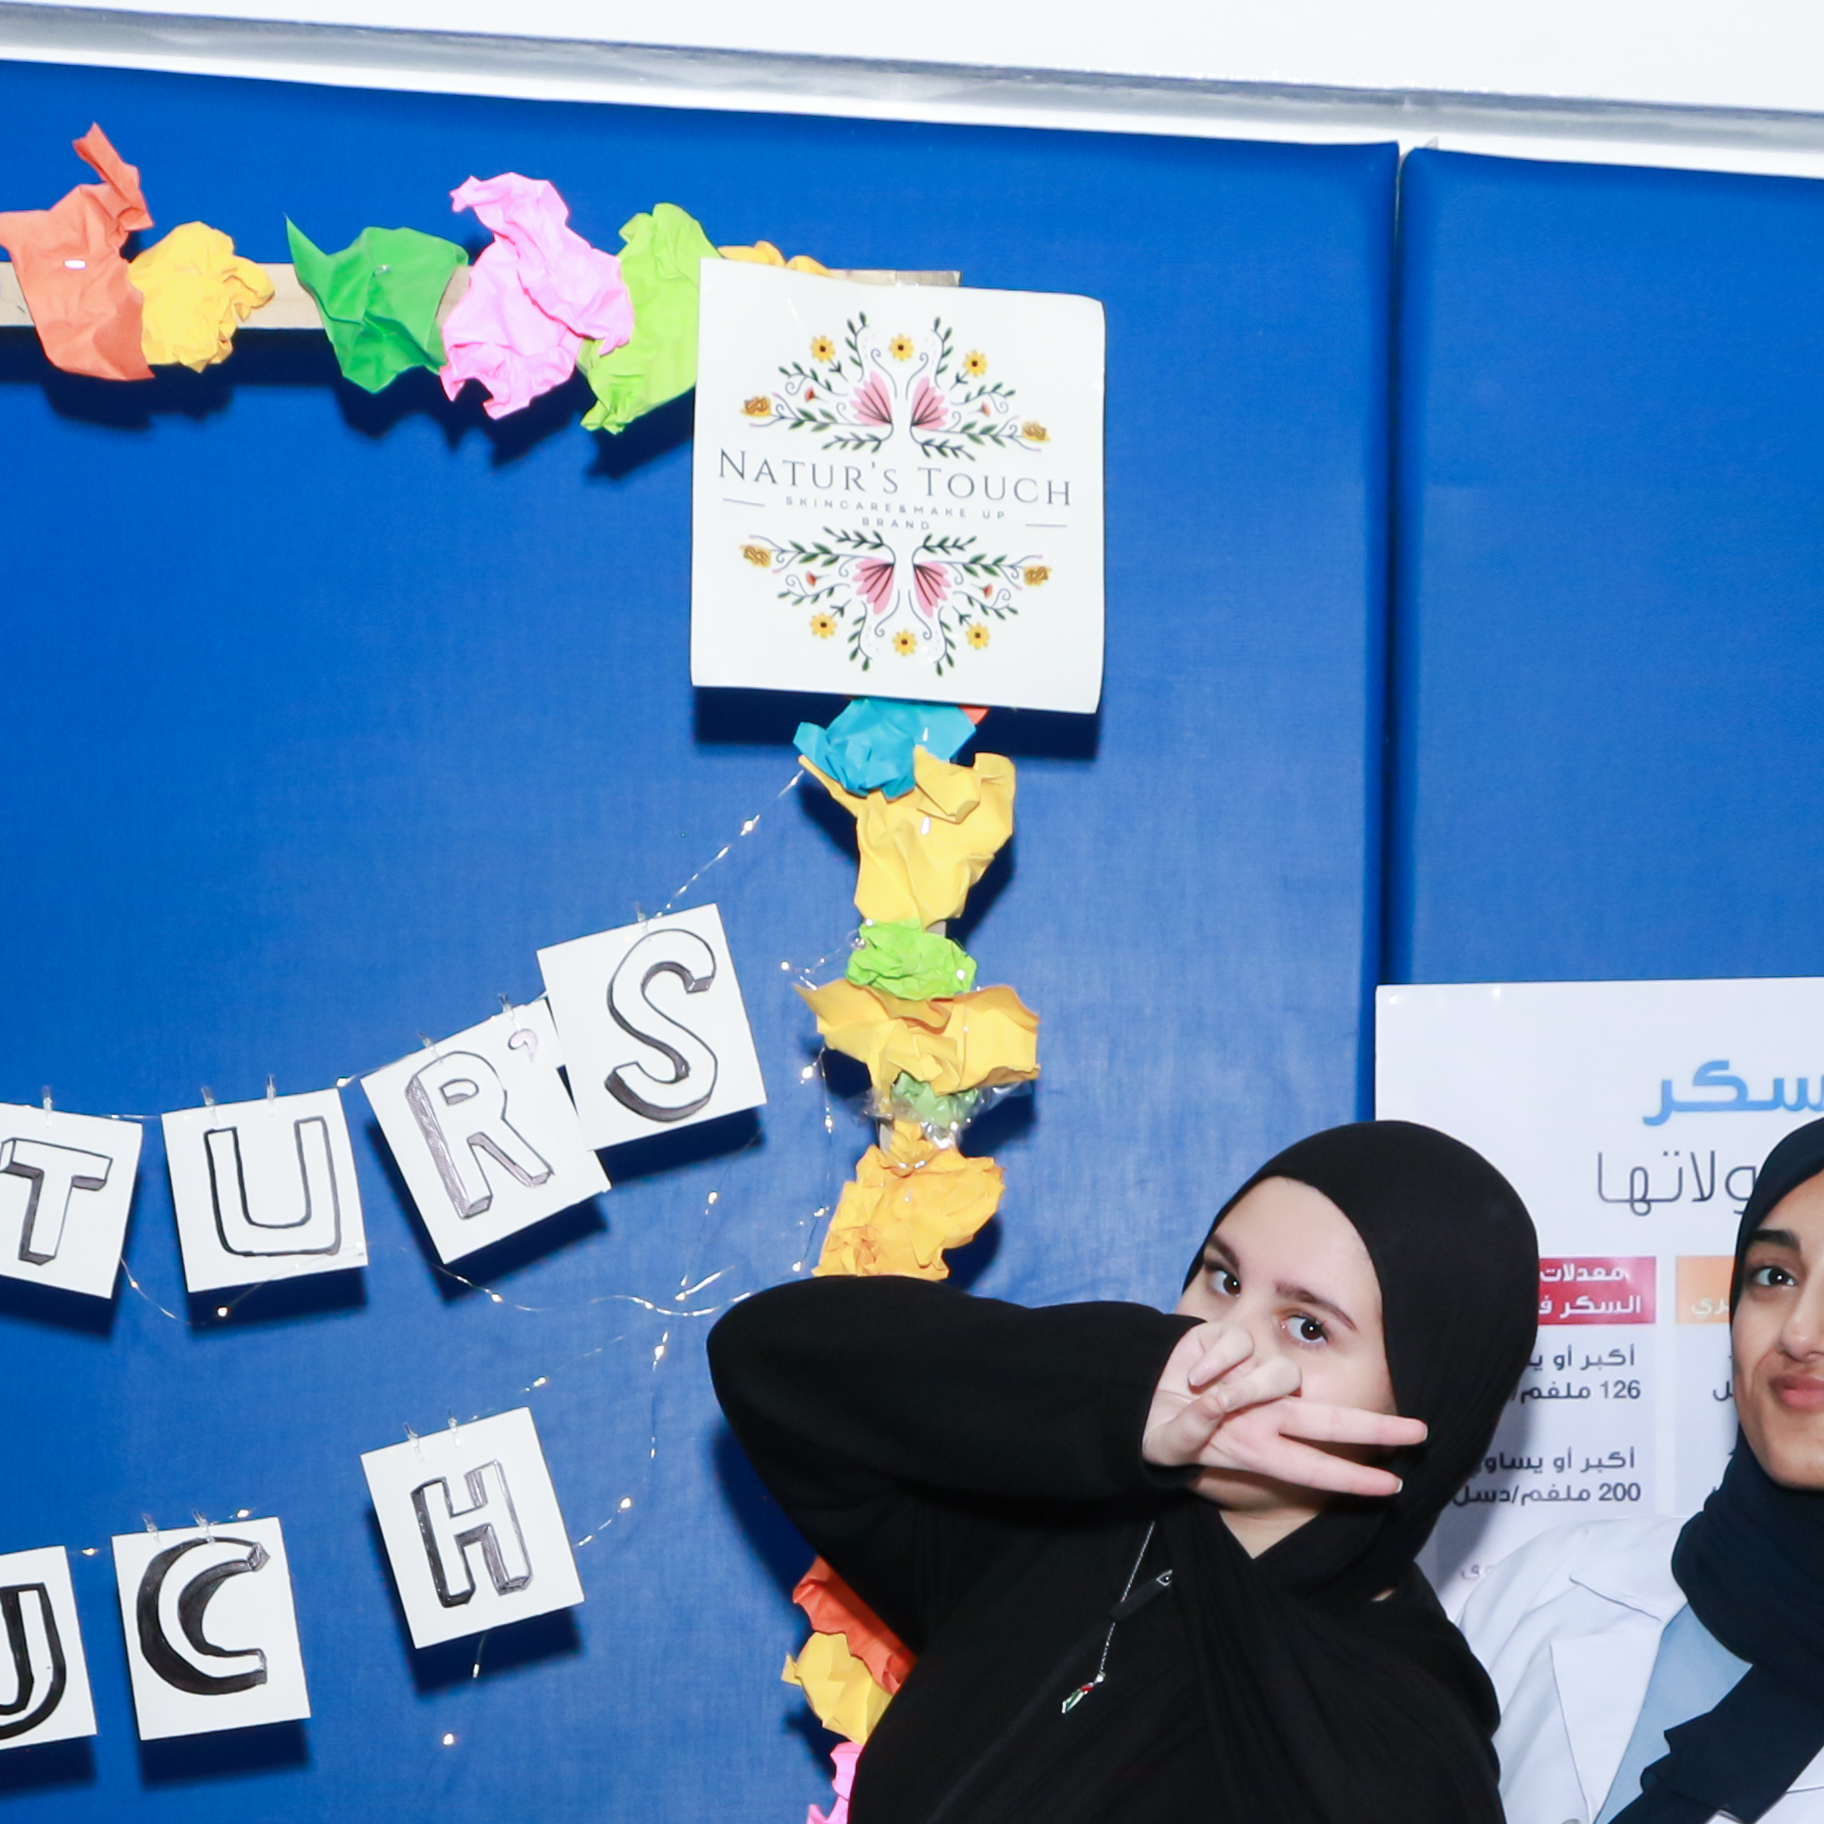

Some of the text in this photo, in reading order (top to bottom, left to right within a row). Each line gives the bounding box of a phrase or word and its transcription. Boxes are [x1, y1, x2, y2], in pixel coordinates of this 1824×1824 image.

[718, 448, 1071, 506] NATUR'S TOUCH
[862, 517, 930, 531] BRAND
[982, 511, 1005, 521] UP
[1559, 1295, 1642, 1319] السكر
[1553, 1345, 1573, 1371] أو
[1581, 1344, 1635, 1371] أكبر
[1599, 1380, 1642, 1400] 126
[1483, 1446, 1635, 1474] أكبر أو يساو
[1598, 1482, 1642, 1502] 200
